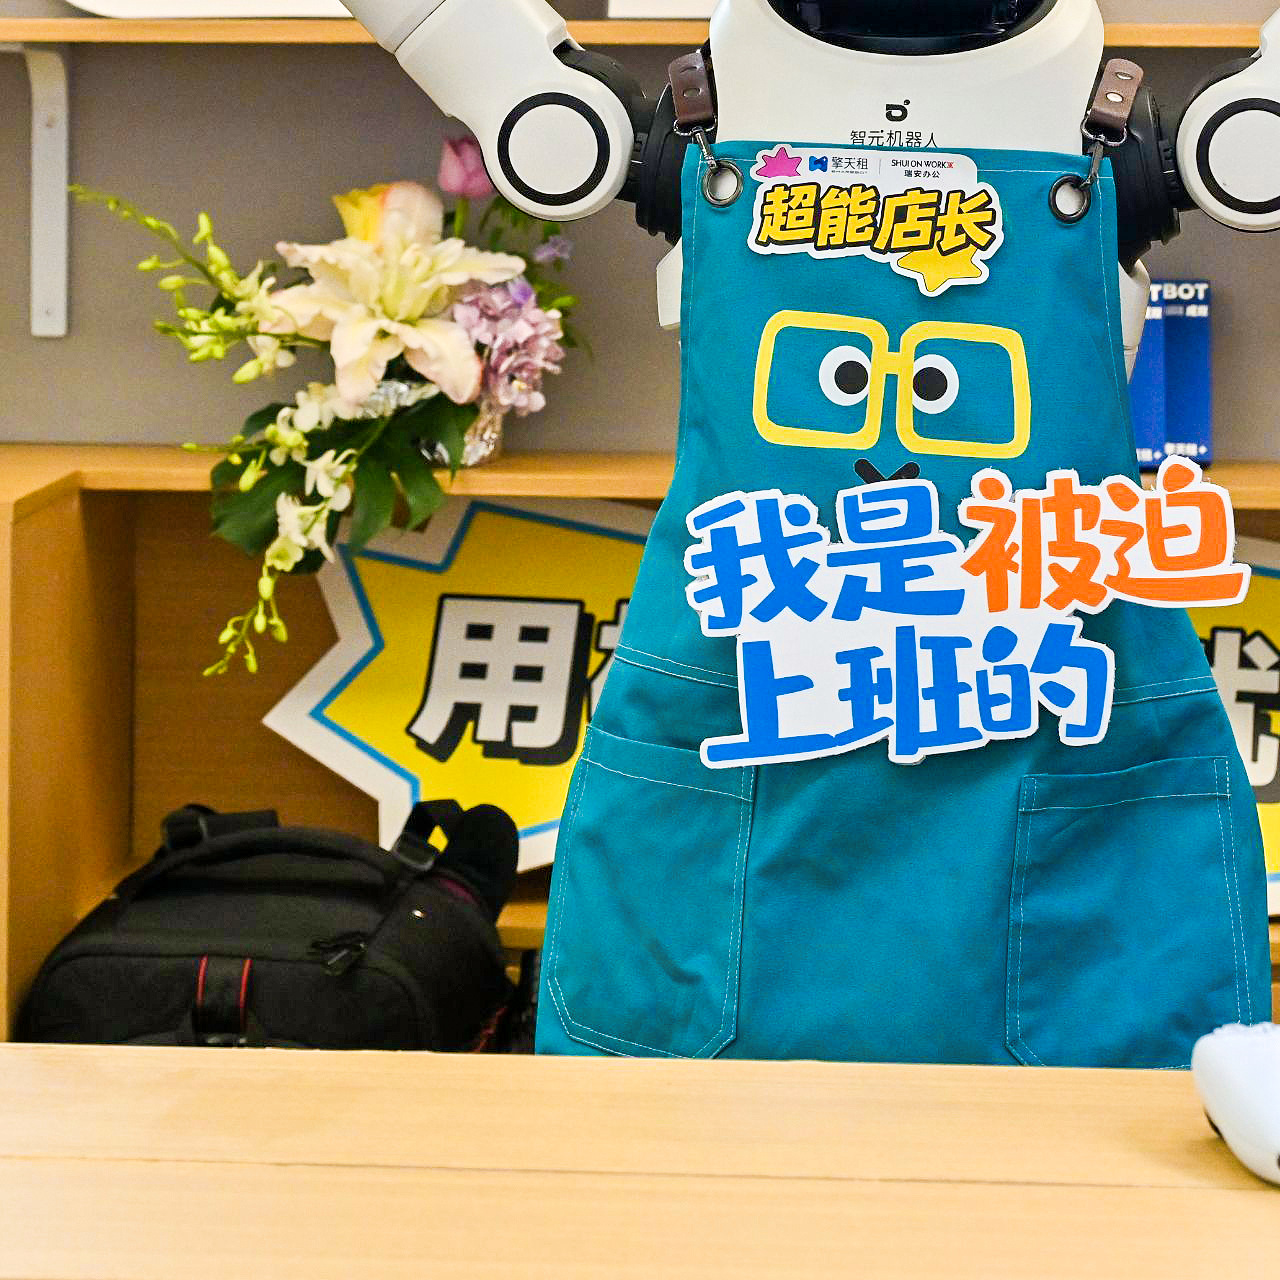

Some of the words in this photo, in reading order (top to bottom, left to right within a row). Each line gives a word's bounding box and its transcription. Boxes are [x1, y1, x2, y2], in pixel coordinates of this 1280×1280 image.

[831, 157, 868, 170] 擎天租
[850, 130, 938, 148] 智元机器人
[904, 170, 940, 178] 瑞安办公
[757, 182, 996, 254] 超能店长
[691, 463, 1243, 629] 我是被迫
[407, 593, 628, 765] 用
[706, 622, 1108, 762] 上班的
